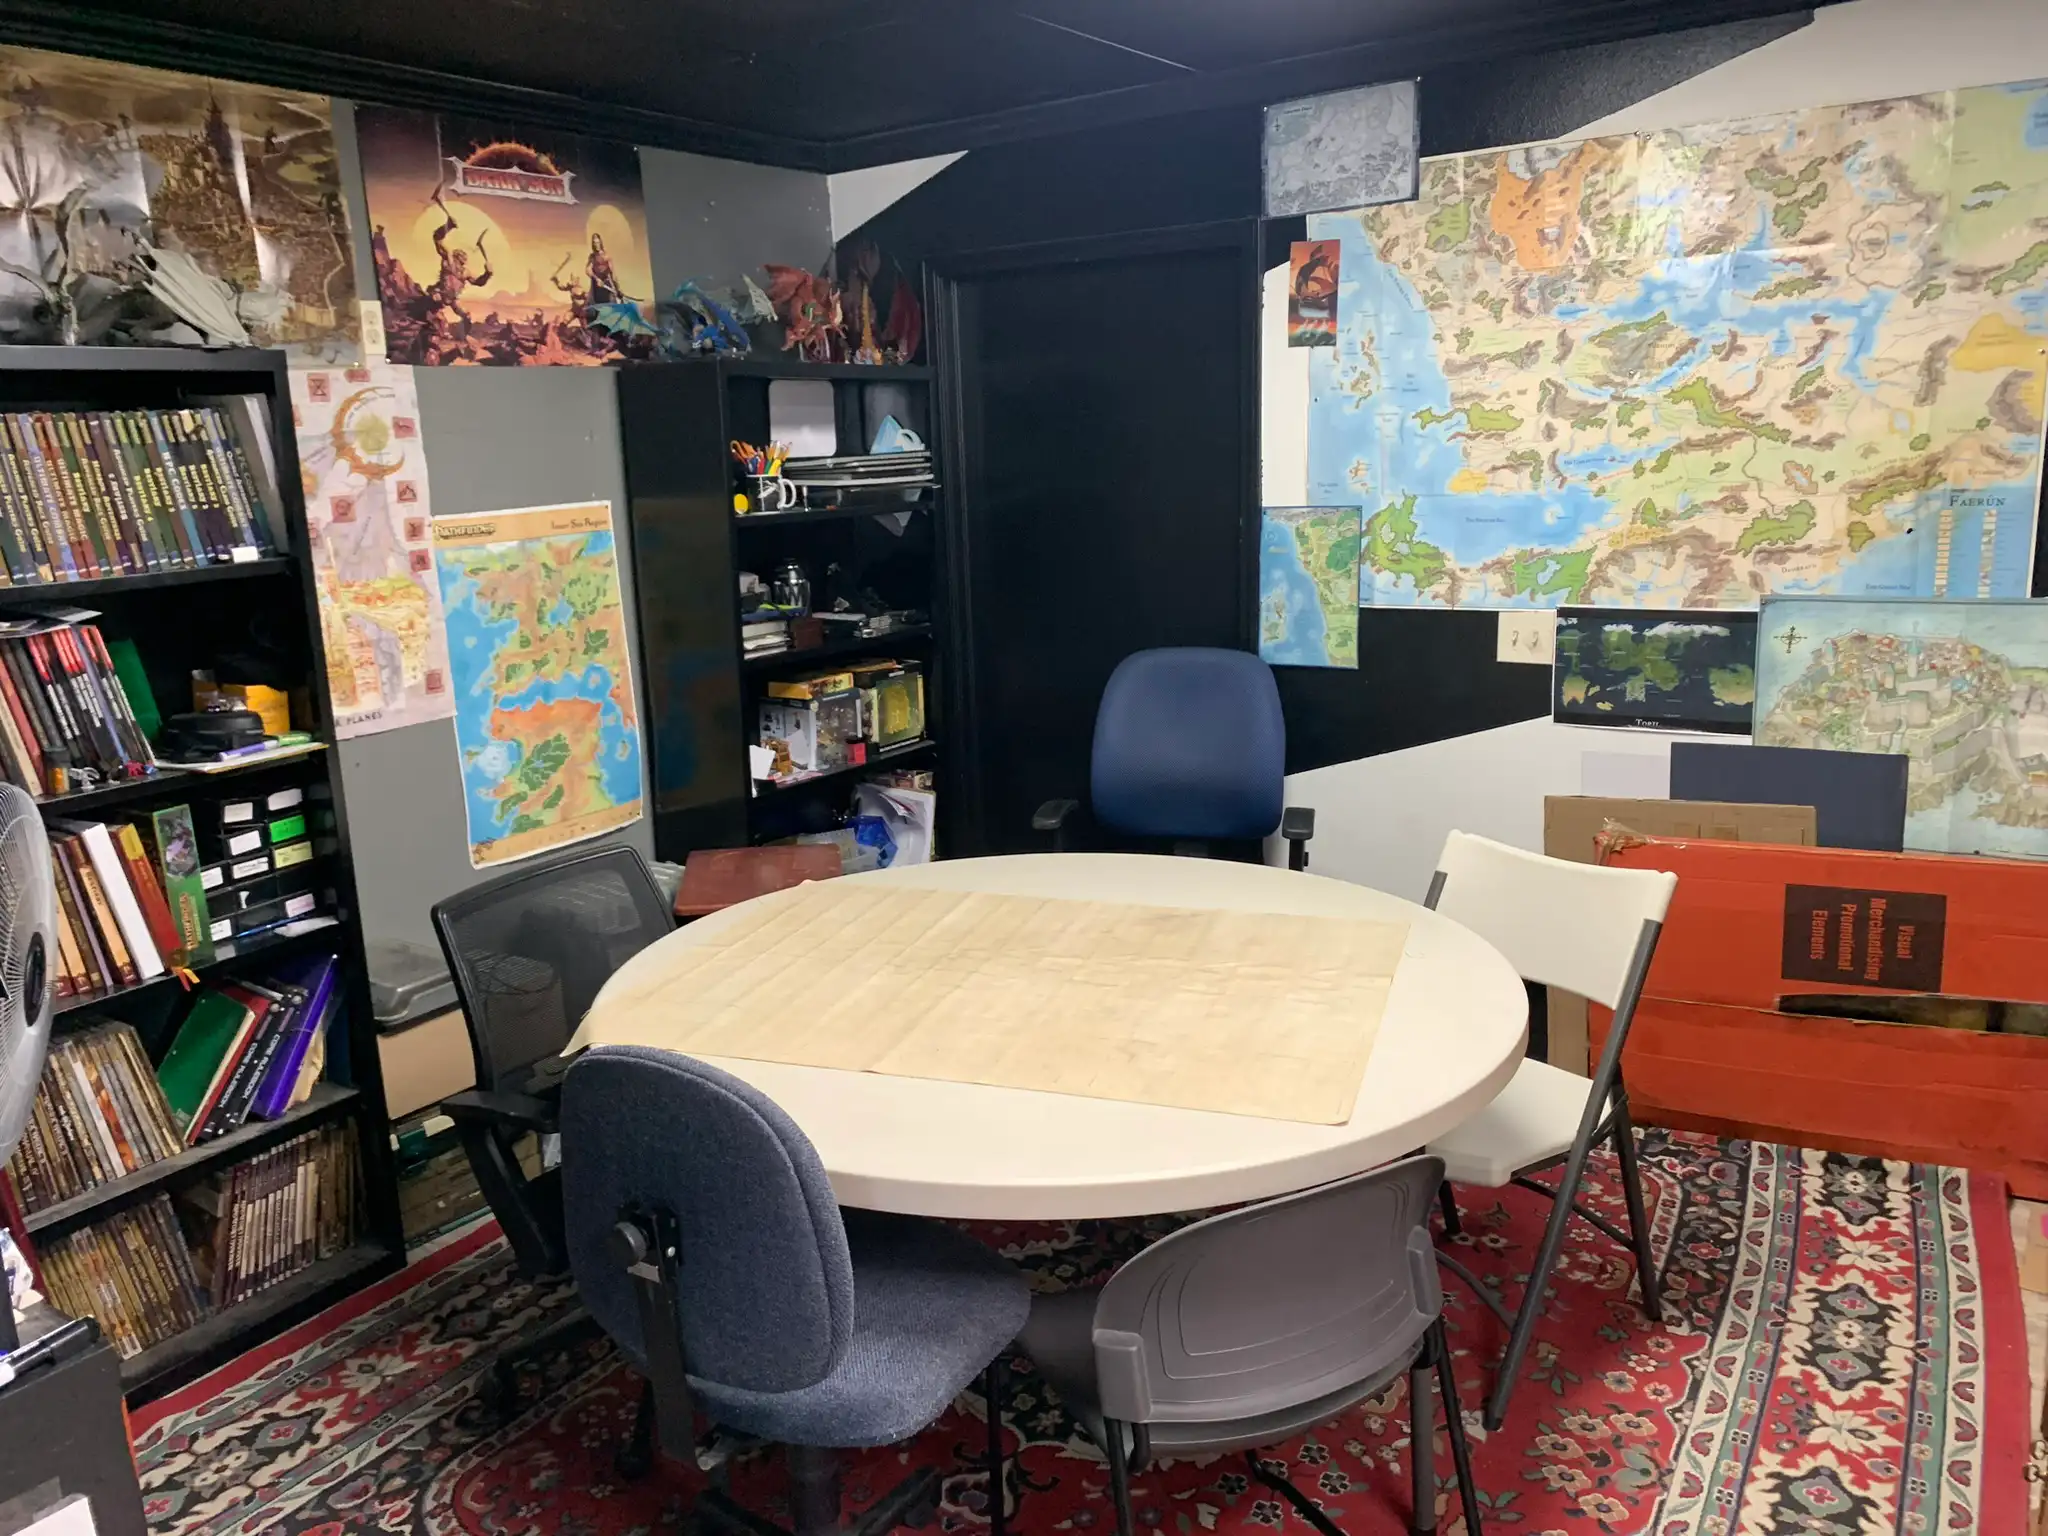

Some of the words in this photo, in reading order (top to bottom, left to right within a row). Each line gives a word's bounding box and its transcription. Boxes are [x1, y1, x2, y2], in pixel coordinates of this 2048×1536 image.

[528, 177, 564, 196] SUN
[1810, 909, 1828, 960] Elements
[1838, 904, 1857, 971] Promotional
[1864, 898, 1886, 981] Merchandising
[1897, 925, 1915, 959] Visual
